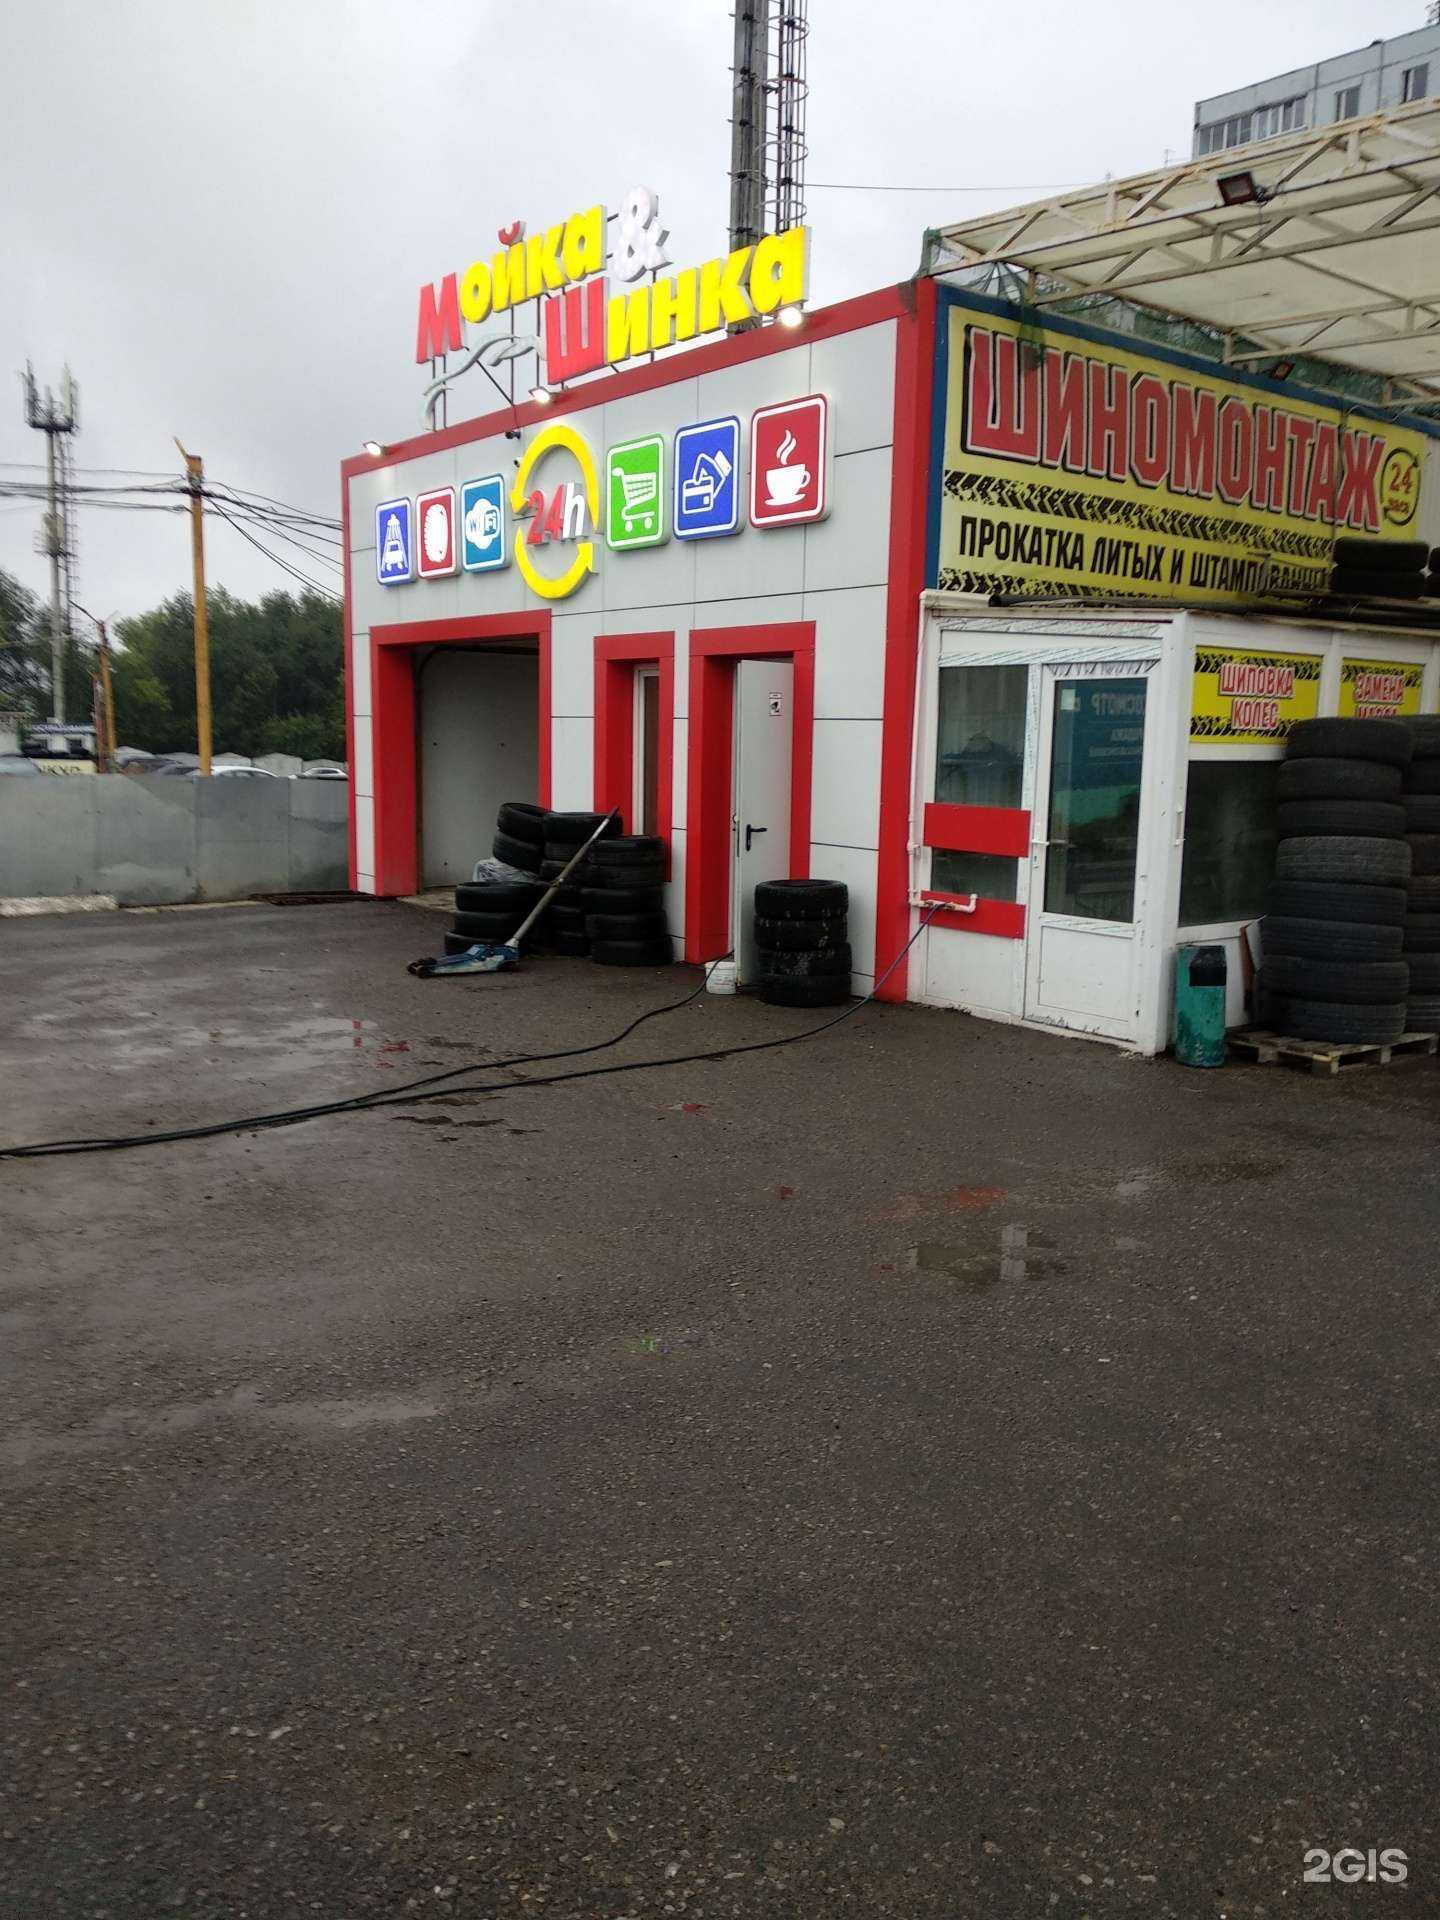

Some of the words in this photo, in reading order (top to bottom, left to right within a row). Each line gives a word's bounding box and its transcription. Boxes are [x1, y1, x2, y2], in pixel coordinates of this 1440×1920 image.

[416, 204, 608, 365] Мойка
[545, 226, 810, 385] Шинка
[962, 324, 1385, 533] ШИНОМОНТАЖ
[1390, 462, 1415, 495] 24
[526, 481, 586, 545] 24h
[960, 515, 1085, 572] ПРОКАТКА
[1089, 536, 1167, 582] ЛИТЫХ
[1169, 548, 1194, 585] И
[1219, 663, 1295, 699] ШИПОВКА
[1354, 672, 1406, 704] ЗАМЕНА
[1231, 697, 1280, 730] КОЛЕС
